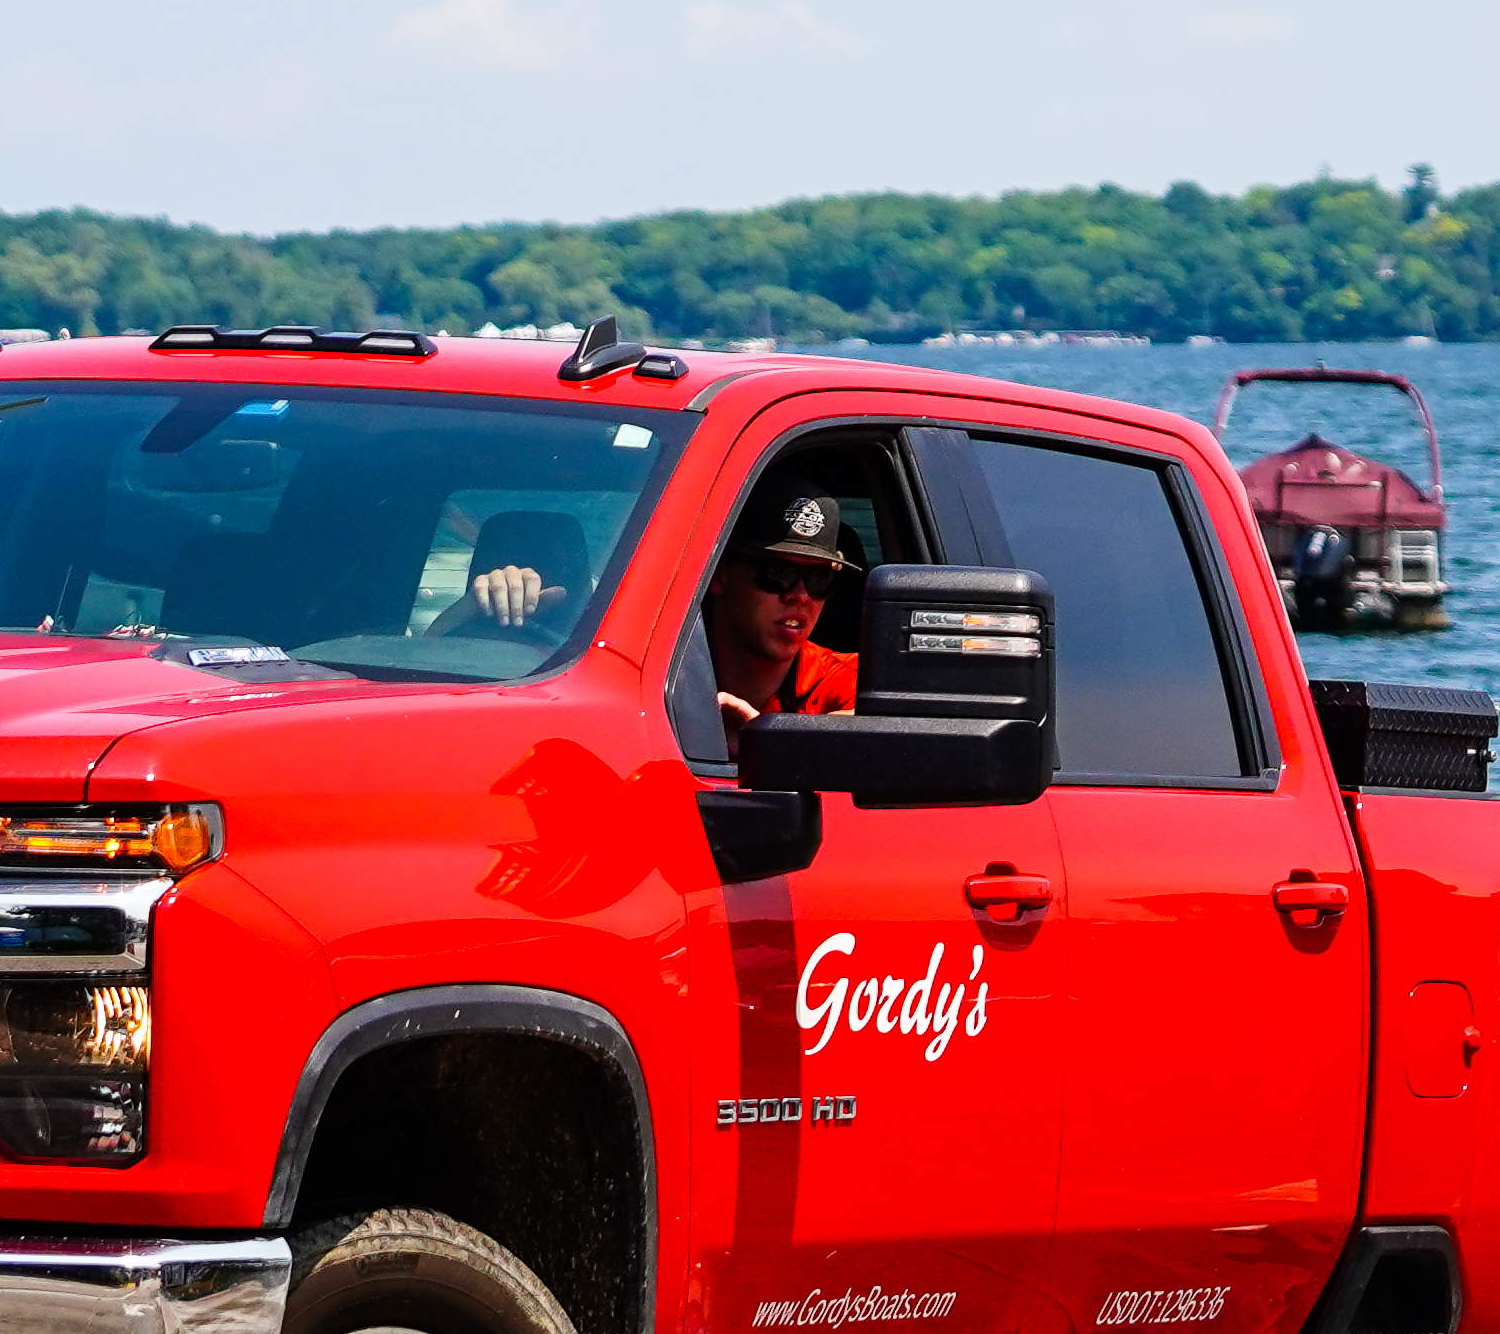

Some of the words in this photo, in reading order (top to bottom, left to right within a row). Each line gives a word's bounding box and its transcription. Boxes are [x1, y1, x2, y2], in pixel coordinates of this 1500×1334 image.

[796, 932, 989, 1062] Gordy's
[716, 1097, 803, 1124] 3500
[811, 1095, 857, 1121] HD
[751, 1285, 957, 1330] www.GordysBoats.com
[1096, 1286, 1232, 1325] USDOT:1296336
